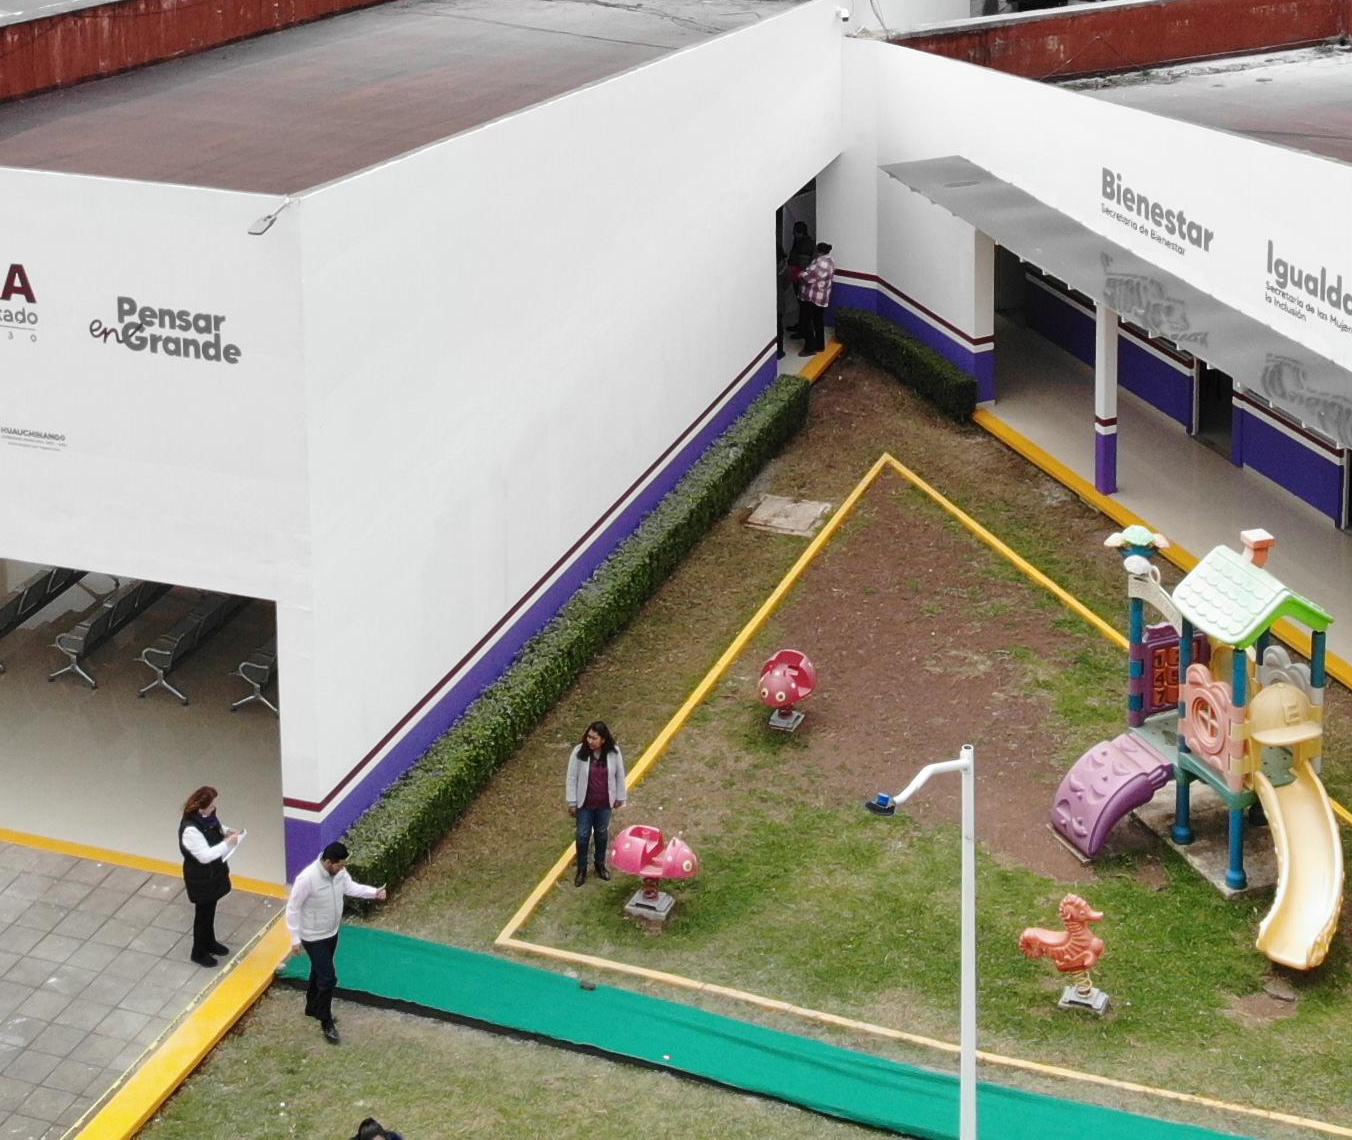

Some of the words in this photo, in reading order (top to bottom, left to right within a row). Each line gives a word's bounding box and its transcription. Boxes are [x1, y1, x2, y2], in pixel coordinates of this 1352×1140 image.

[1102, 166, 1214, 253] Bienestar
[1139, 224, 1149, 237] de
[117, 295, 226, 335] Pensar
[1305, 301, 1315, 314] de
[89, 318, 138, 345] en
[121, 321, 242, 364] Grande
